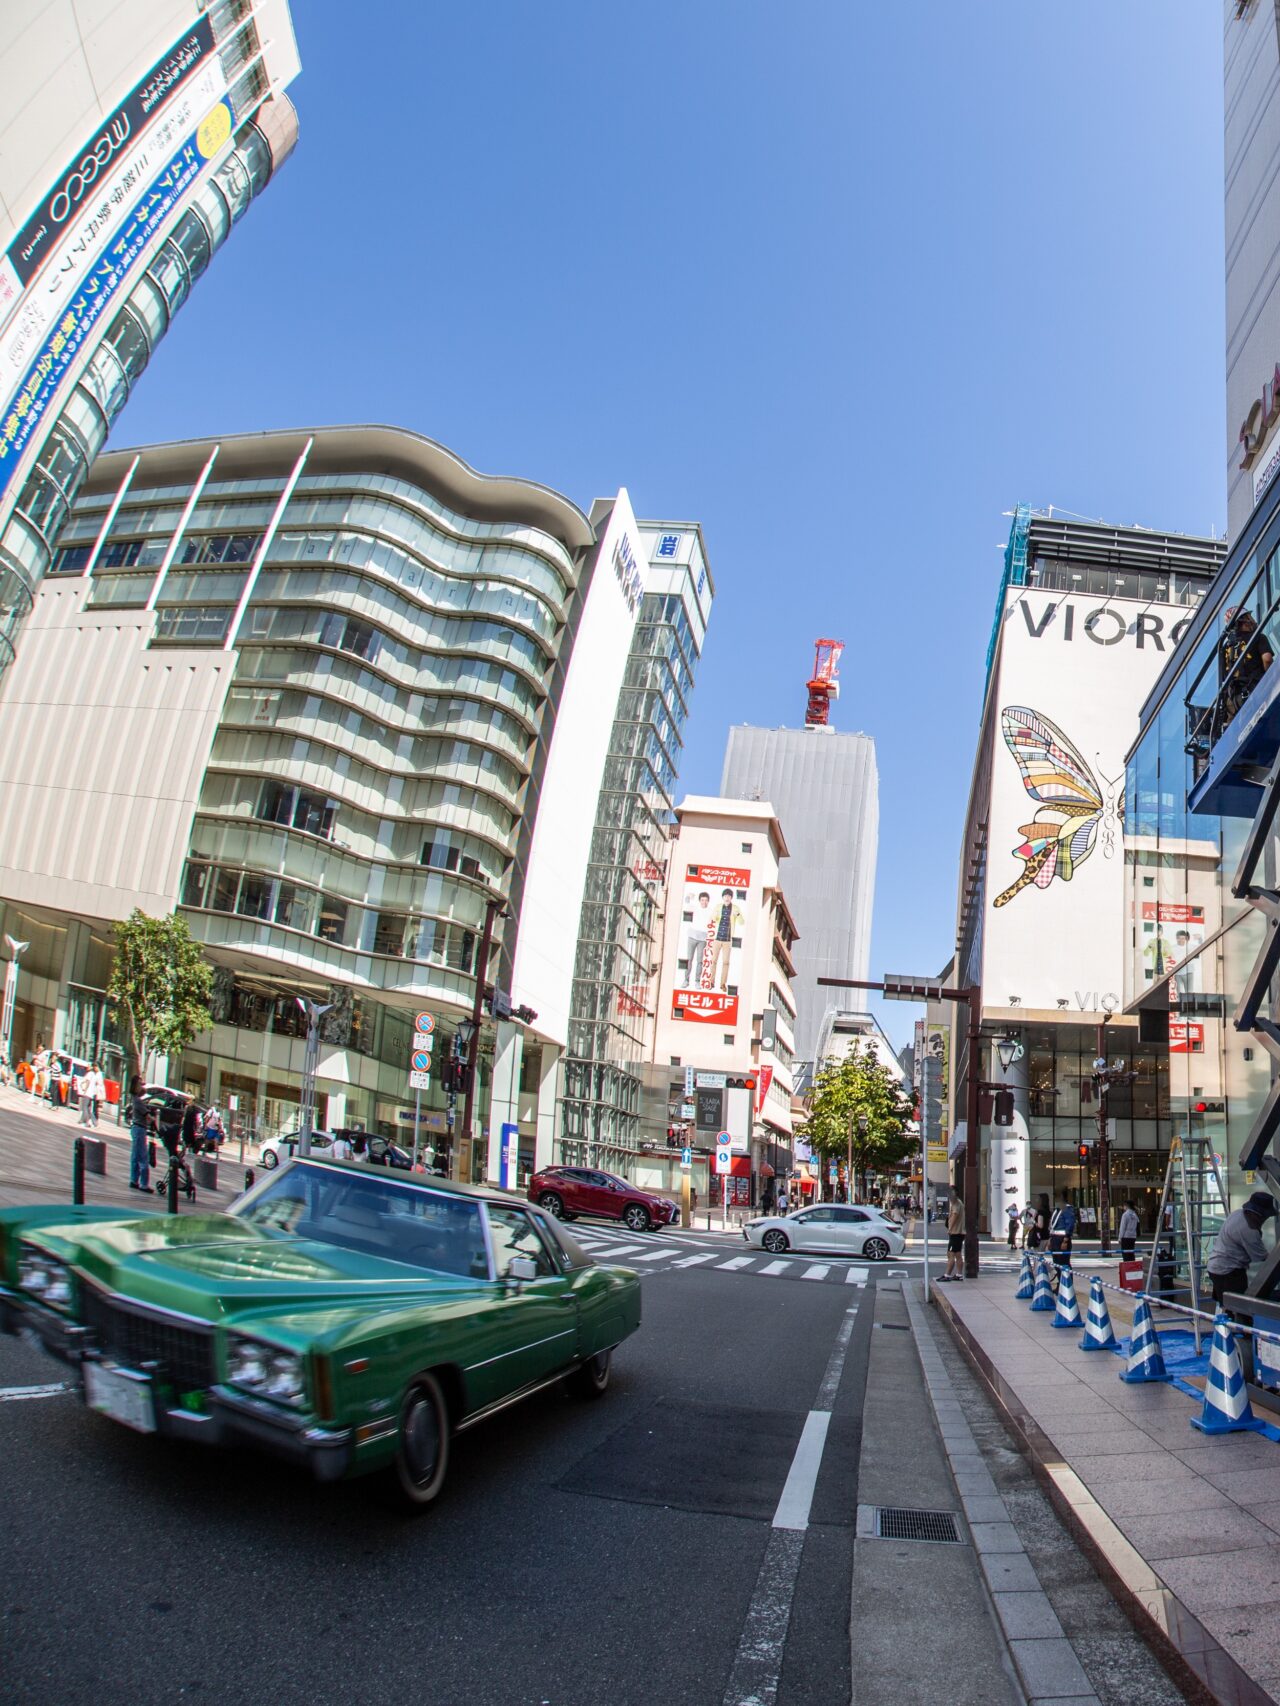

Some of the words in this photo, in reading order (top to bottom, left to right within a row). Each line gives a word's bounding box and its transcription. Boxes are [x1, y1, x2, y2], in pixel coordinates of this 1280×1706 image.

[658, 535, 678, 556] 岩
[408, 571, 457, 597] air
[717, 876, 747, 886] PLAZA
[700, 919, 717, 990] よっていかんね
[677, 993, 713, 1007] 当ビル
[718, 997, 734, 1009] 1F
